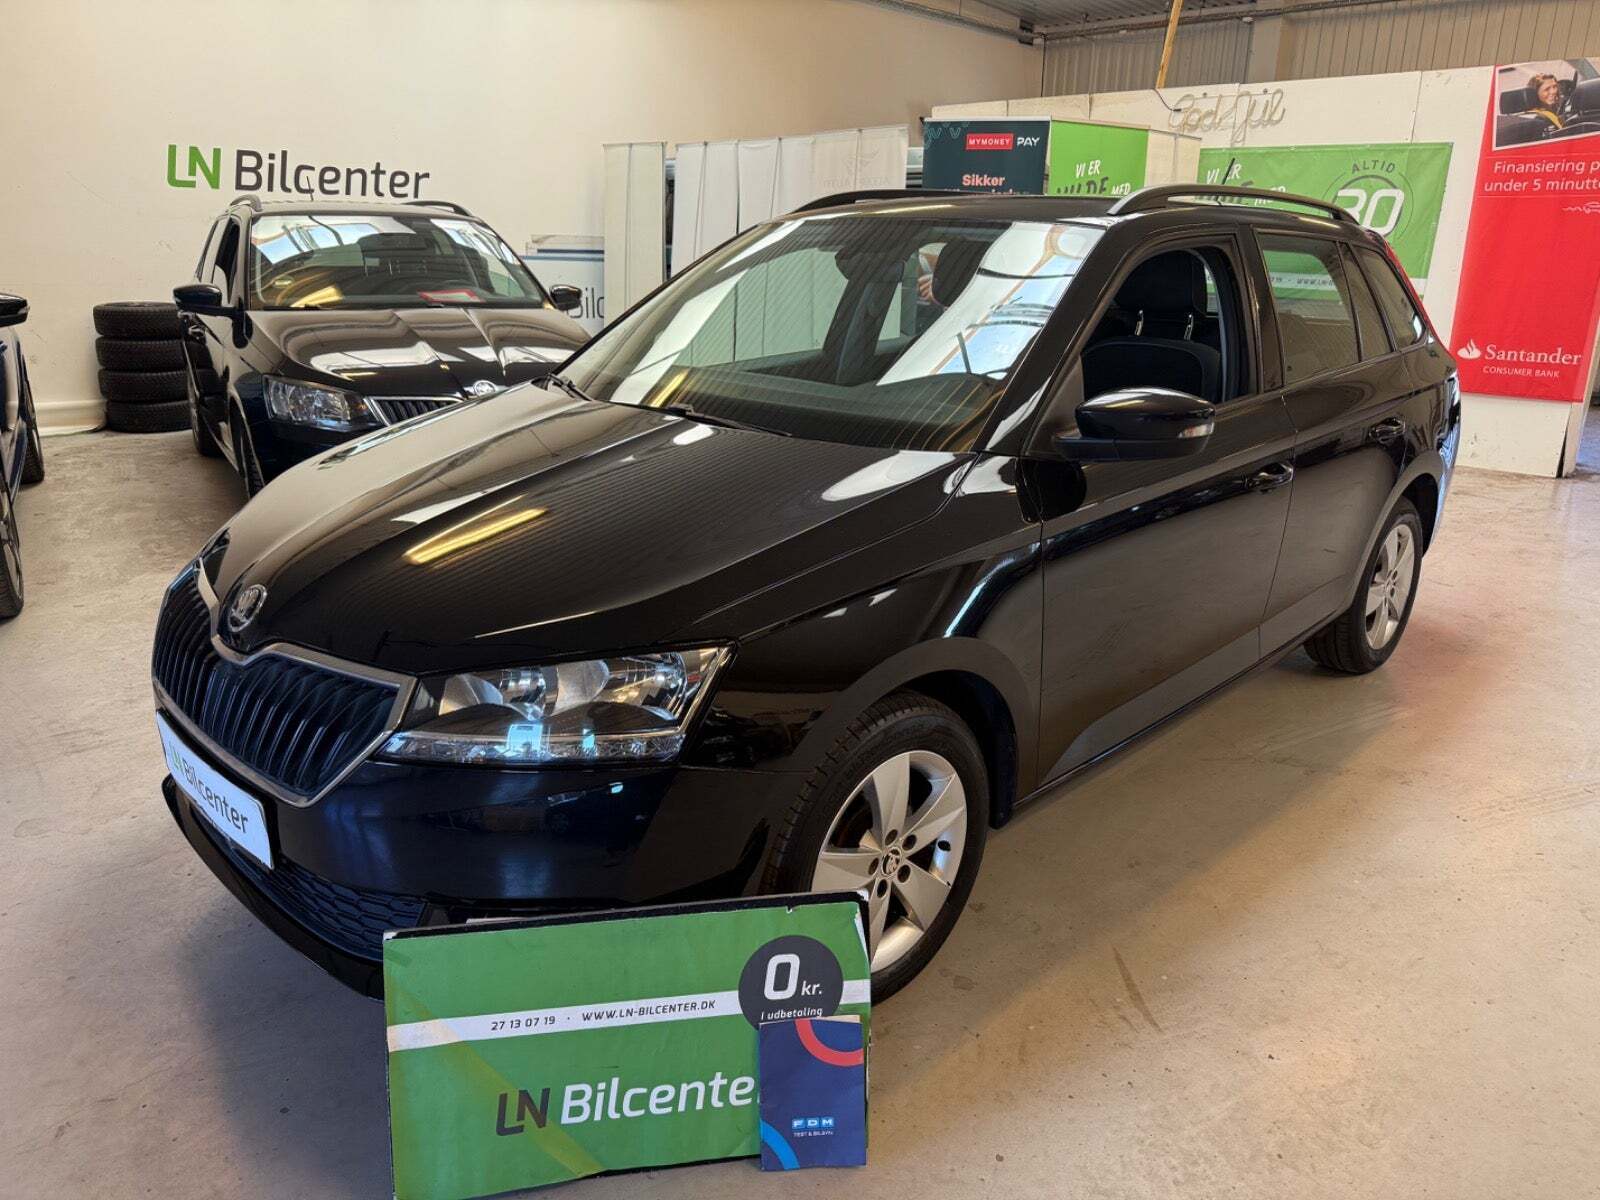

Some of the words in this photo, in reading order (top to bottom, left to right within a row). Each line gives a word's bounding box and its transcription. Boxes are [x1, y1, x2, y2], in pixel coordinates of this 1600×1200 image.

[968, 138, 1010, 146] MYMONEY
[1016, 137, 1040, 147] PAY
[167, 144, 222, 189] LN
[234, 149, 430, 199] Bilcenter
[1088, 160, 1101, 175] ER
[1351, 160, 1396, 175] ALTID
[1494, 159, 1585, 175] Finansiering
[1484, 179, 1529, 192] under
[1532, 179, 1541, 191] 5
[1546, 177, 1600, 191] minutt
[1485, 344, 1582, 365] Santander
[1483, 365, 1532, 376] CONSUMER
[1534, 368, 1560, 378] BANK
[182, 757, 249, 834] Bilcenter
[764, 953, 800, 1000] 0
[801, 980, 822, 996] kr.
[490, 1021, 506, 1031] 27
[509, 1019, 522, 1029] 13
[525, 1017, 540, 1028] 07
[544, 1015, 556, 1025] 19
[582, 1000, 716, 1021] WWW.LN-BILCENTER.DK
[767, 1007, 823, 1020] udbetaling
[496, 1087, 550, 1136] LN
[560, 1072, 760, 1125] Bilcente
